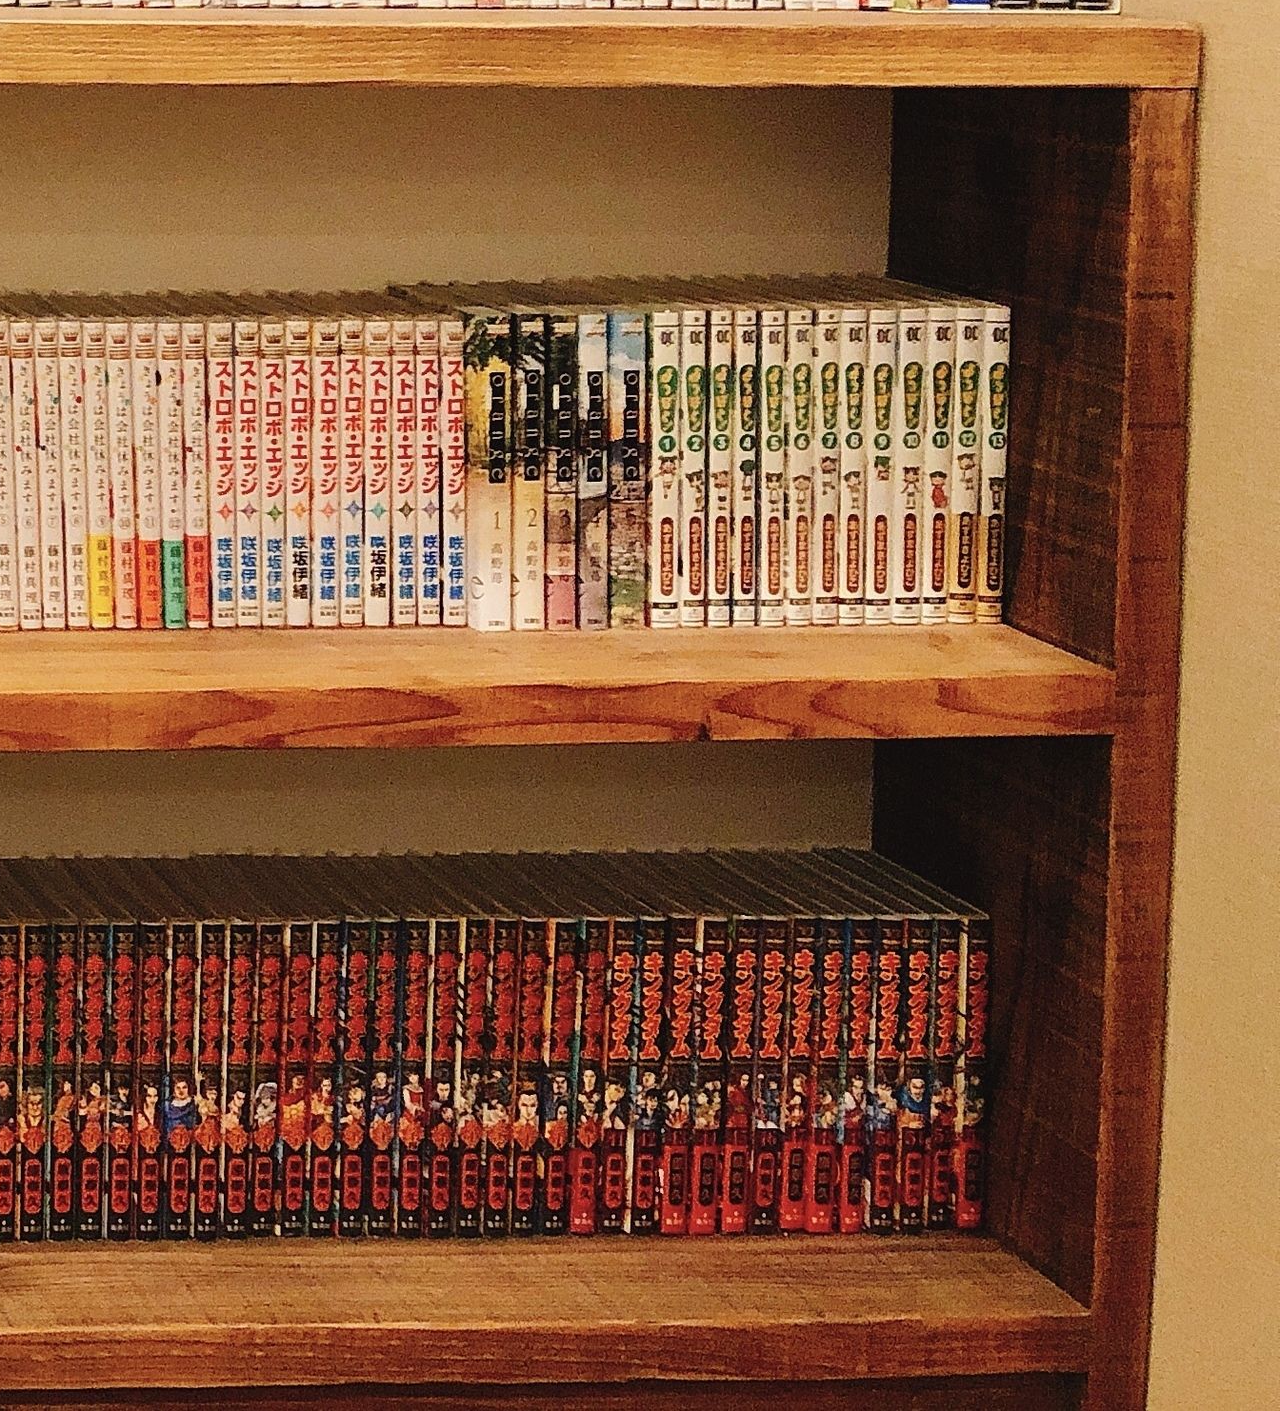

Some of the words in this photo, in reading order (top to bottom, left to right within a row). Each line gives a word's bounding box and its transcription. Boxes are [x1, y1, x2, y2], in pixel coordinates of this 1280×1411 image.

[215, 361, 234, 496] ストロボ・エッジ
[290, 359, 310, 495] ストロボ・エッジ
[370, 360, 389, 496] ストロボ・エッジ
[291, 535, 309, 600] 咲坂伊緒
[493, 511, 501, 530] 1
[527, 508, 537, 527] 2
[640, 950, 665, 1060] キングダム
[669, 949, 694, 1059] キングダム
[731, 949, 756, 1059] キングダム
[759, 950, 784, 1060] キングダム
